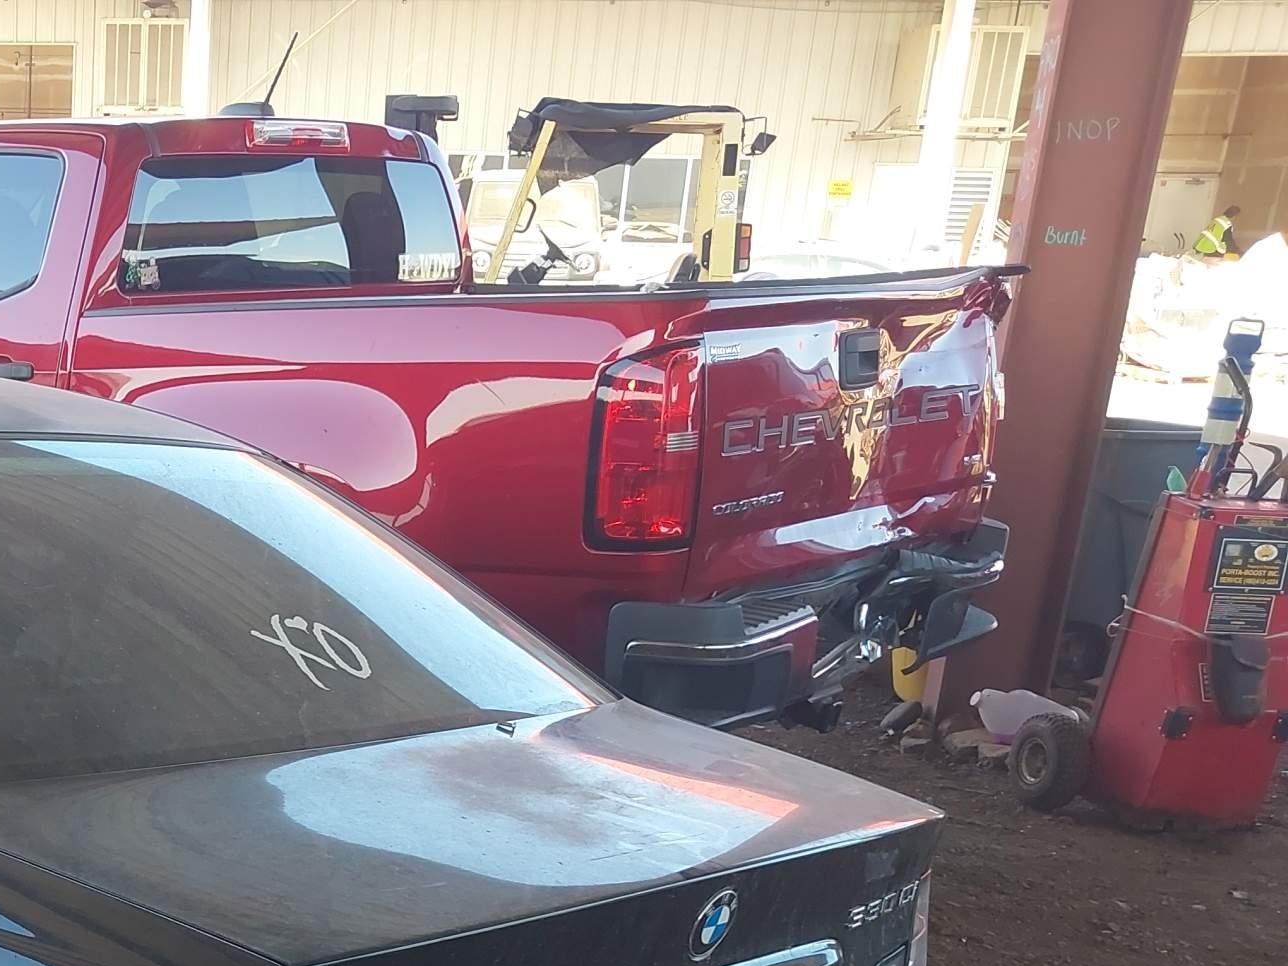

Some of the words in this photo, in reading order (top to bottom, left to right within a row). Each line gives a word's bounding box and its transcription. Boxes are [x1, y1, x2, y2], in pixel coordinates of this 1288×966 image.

[1055, 117, 1121, 144] INOP
[1044, 225, 1088, 246] Burnt
[721, 384, 980, 457] CHEVROLET
